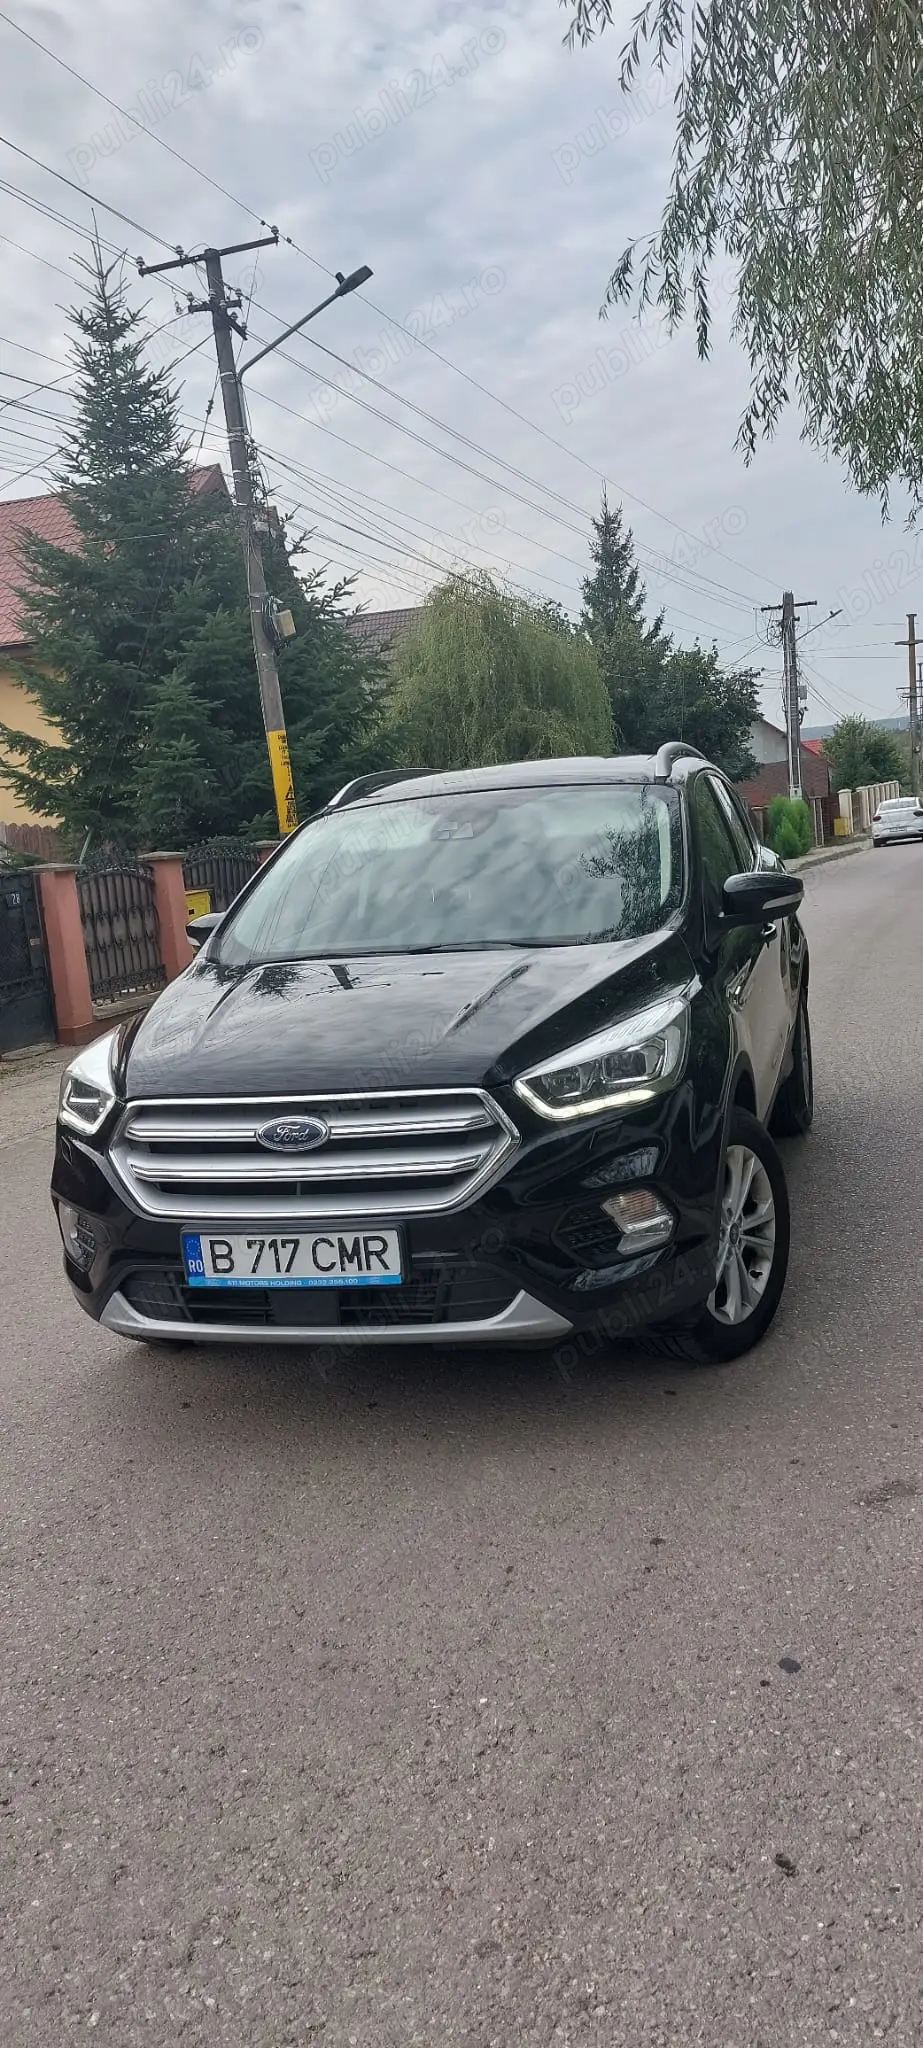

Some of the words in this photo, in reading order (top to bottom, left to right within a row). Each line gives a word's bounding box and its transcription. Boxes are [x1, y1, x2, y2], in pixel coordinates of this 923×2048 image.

[273, 1125, 310, 1142] Ford
[188, 1259, 204, 1273] RO
[208, 1239, 235, 1274] B
[246, 1238, 300, 1274] 717
[311, 1235, 390, 1273] CMR
